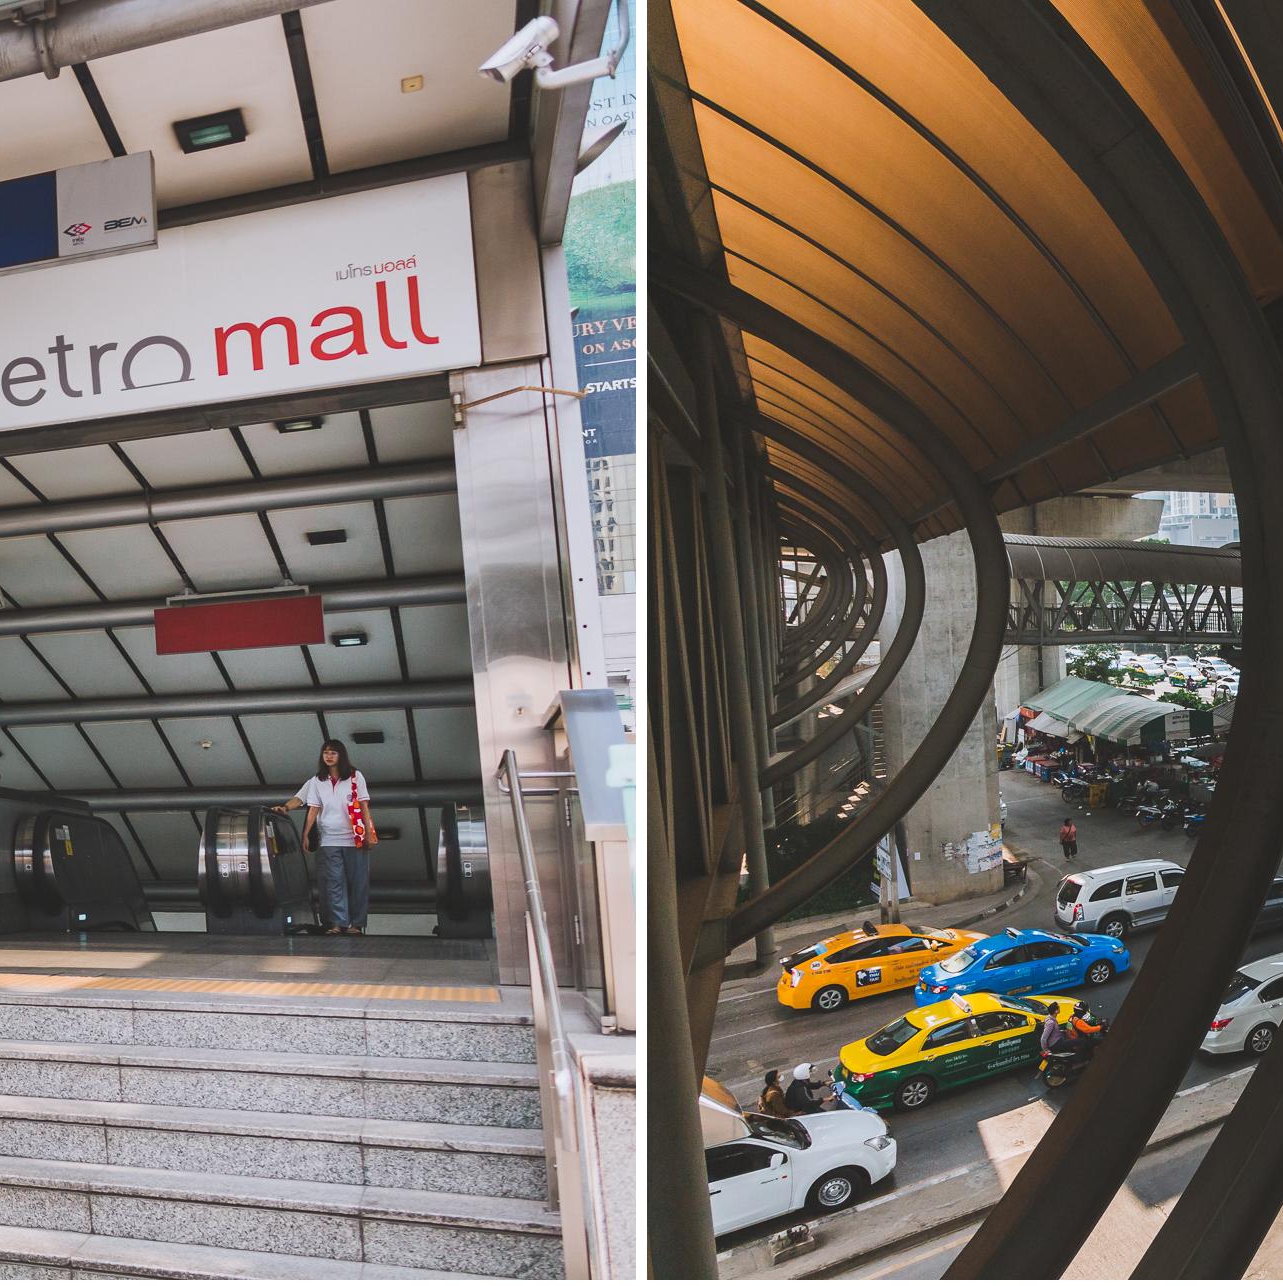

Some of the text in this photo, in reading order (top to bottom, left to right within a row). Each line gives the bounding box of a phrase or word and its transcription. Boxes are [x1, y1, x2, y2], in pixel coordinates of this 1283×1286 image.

[588, 96, 615, 111] ST
[602, 111, 636, 126] OASI
[214, 275, 440, 377] mall
[582, 342, 605, 355] ON
